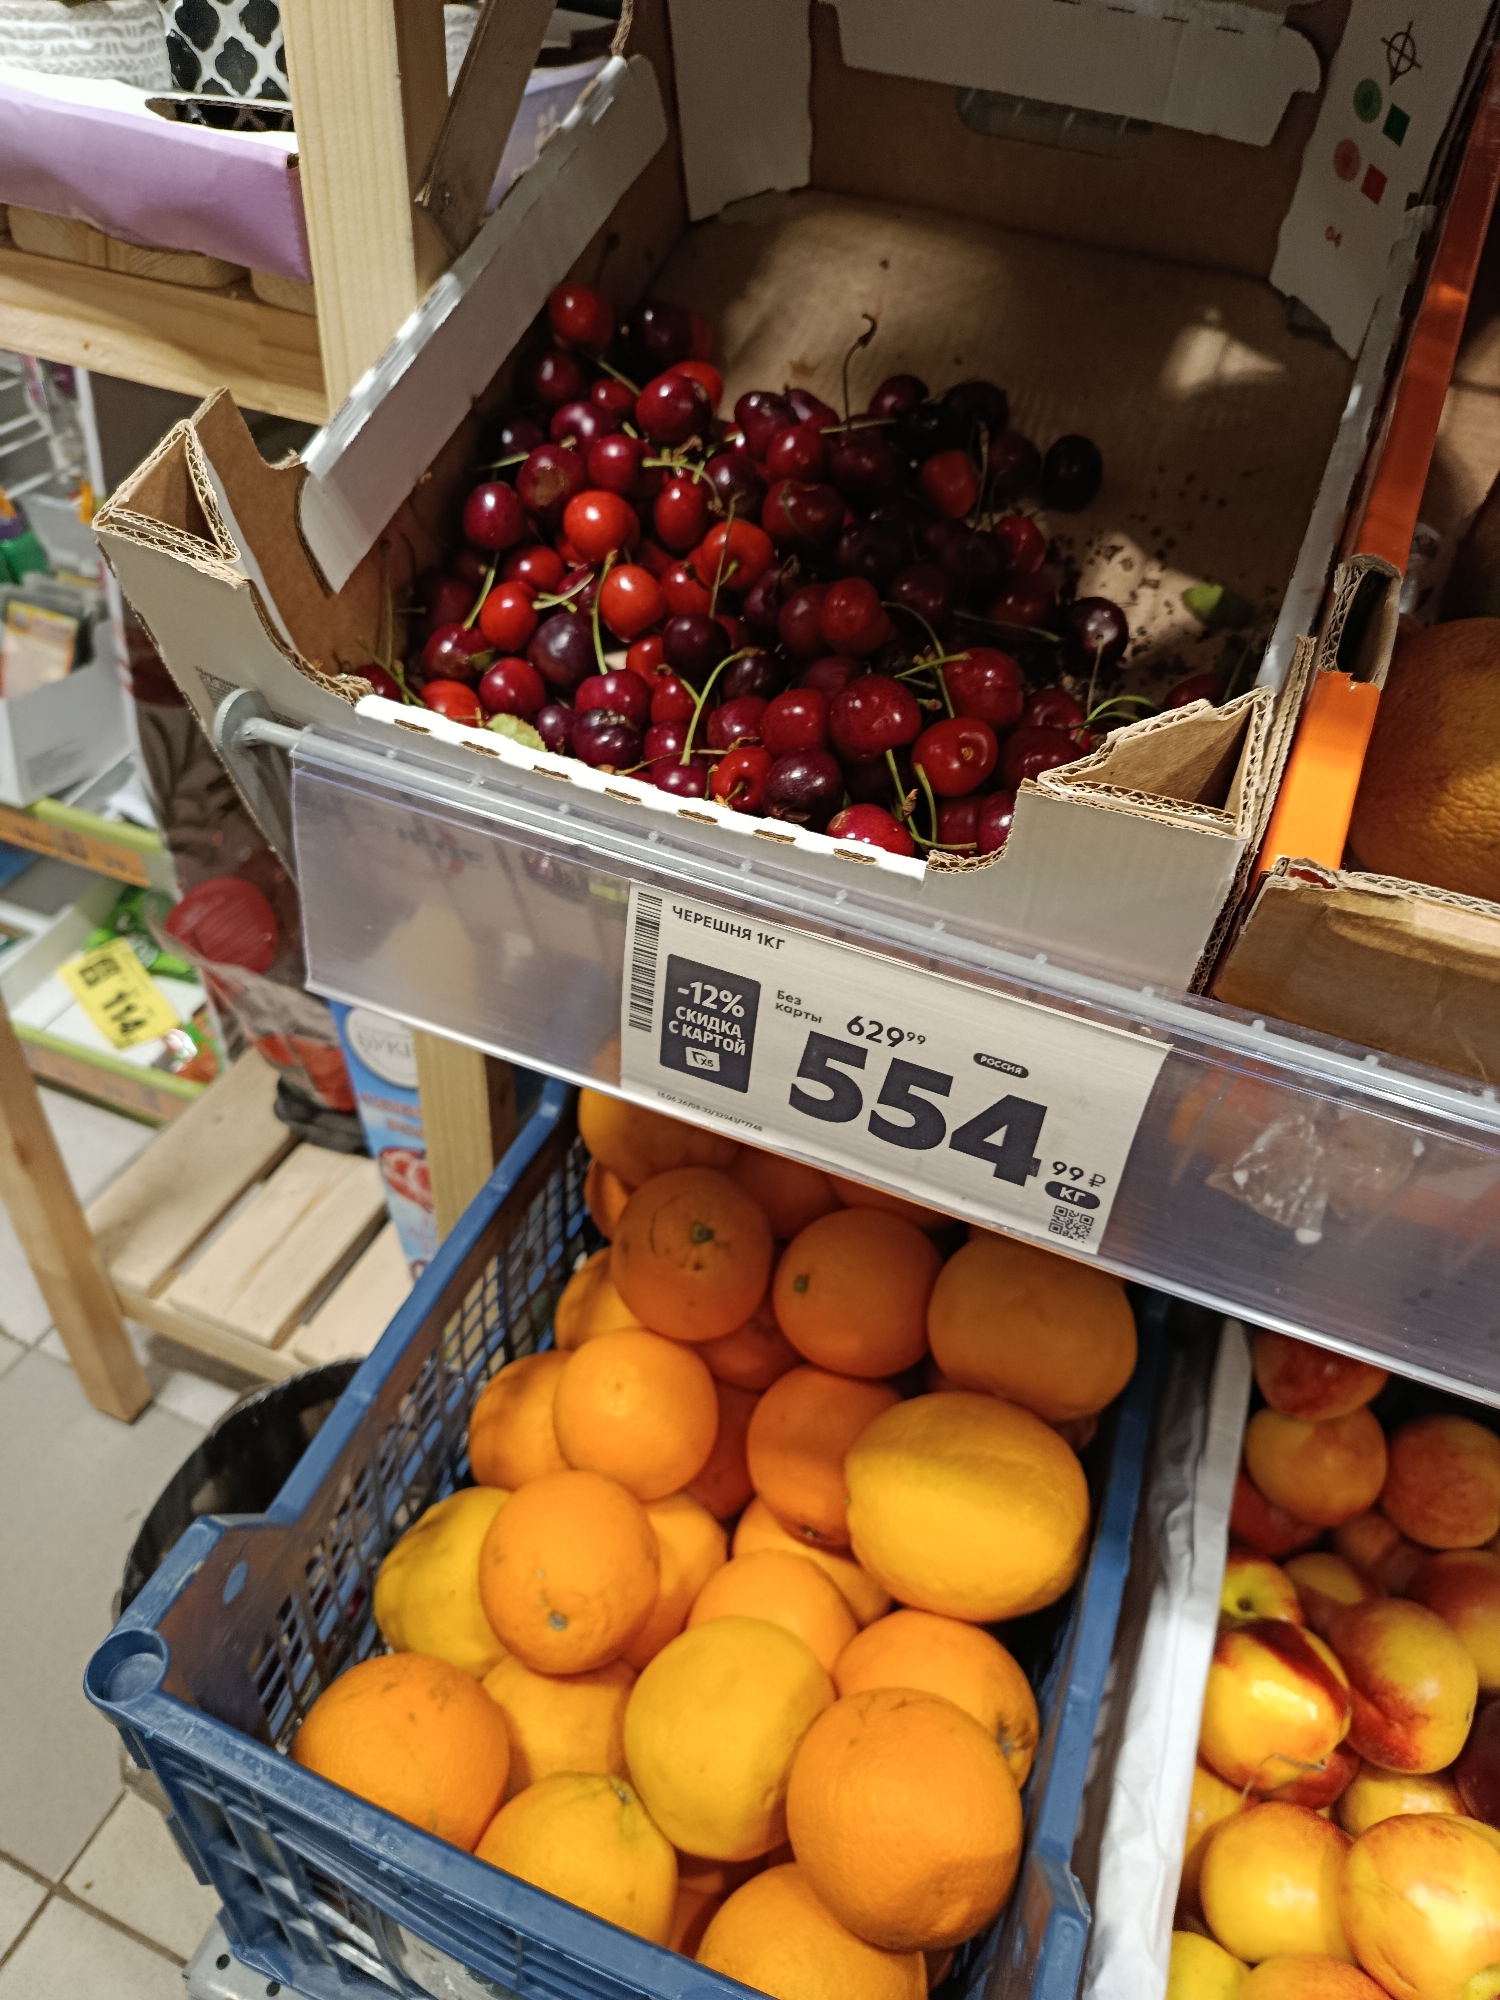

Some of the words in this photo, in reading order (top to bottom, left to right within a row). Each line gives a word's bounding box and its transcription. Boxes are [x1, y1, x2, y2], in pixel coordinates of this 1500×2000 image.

[672, 905, 752, 941] ЧЕРЕШНЯ
[756, 932, 785, 950] 1КГ
[677, 981, 745, 1018] -12%
[776, 990, 802, 1006] Без
[675, 1006, 742, 1038] СКИДКА
[774, 1002, 822, 1024] карты
[668, 1020, 679, 1034] С
[681, 1025, 746, 1056] КАРТОЙ
[980, 1054, 1023, 1076] РОССИЯ
[788, 1030, 1048, 1187] 554
[1051, 1161, 1085, 1182] 99
[1058, 1186, 1087, 1203] КГ
